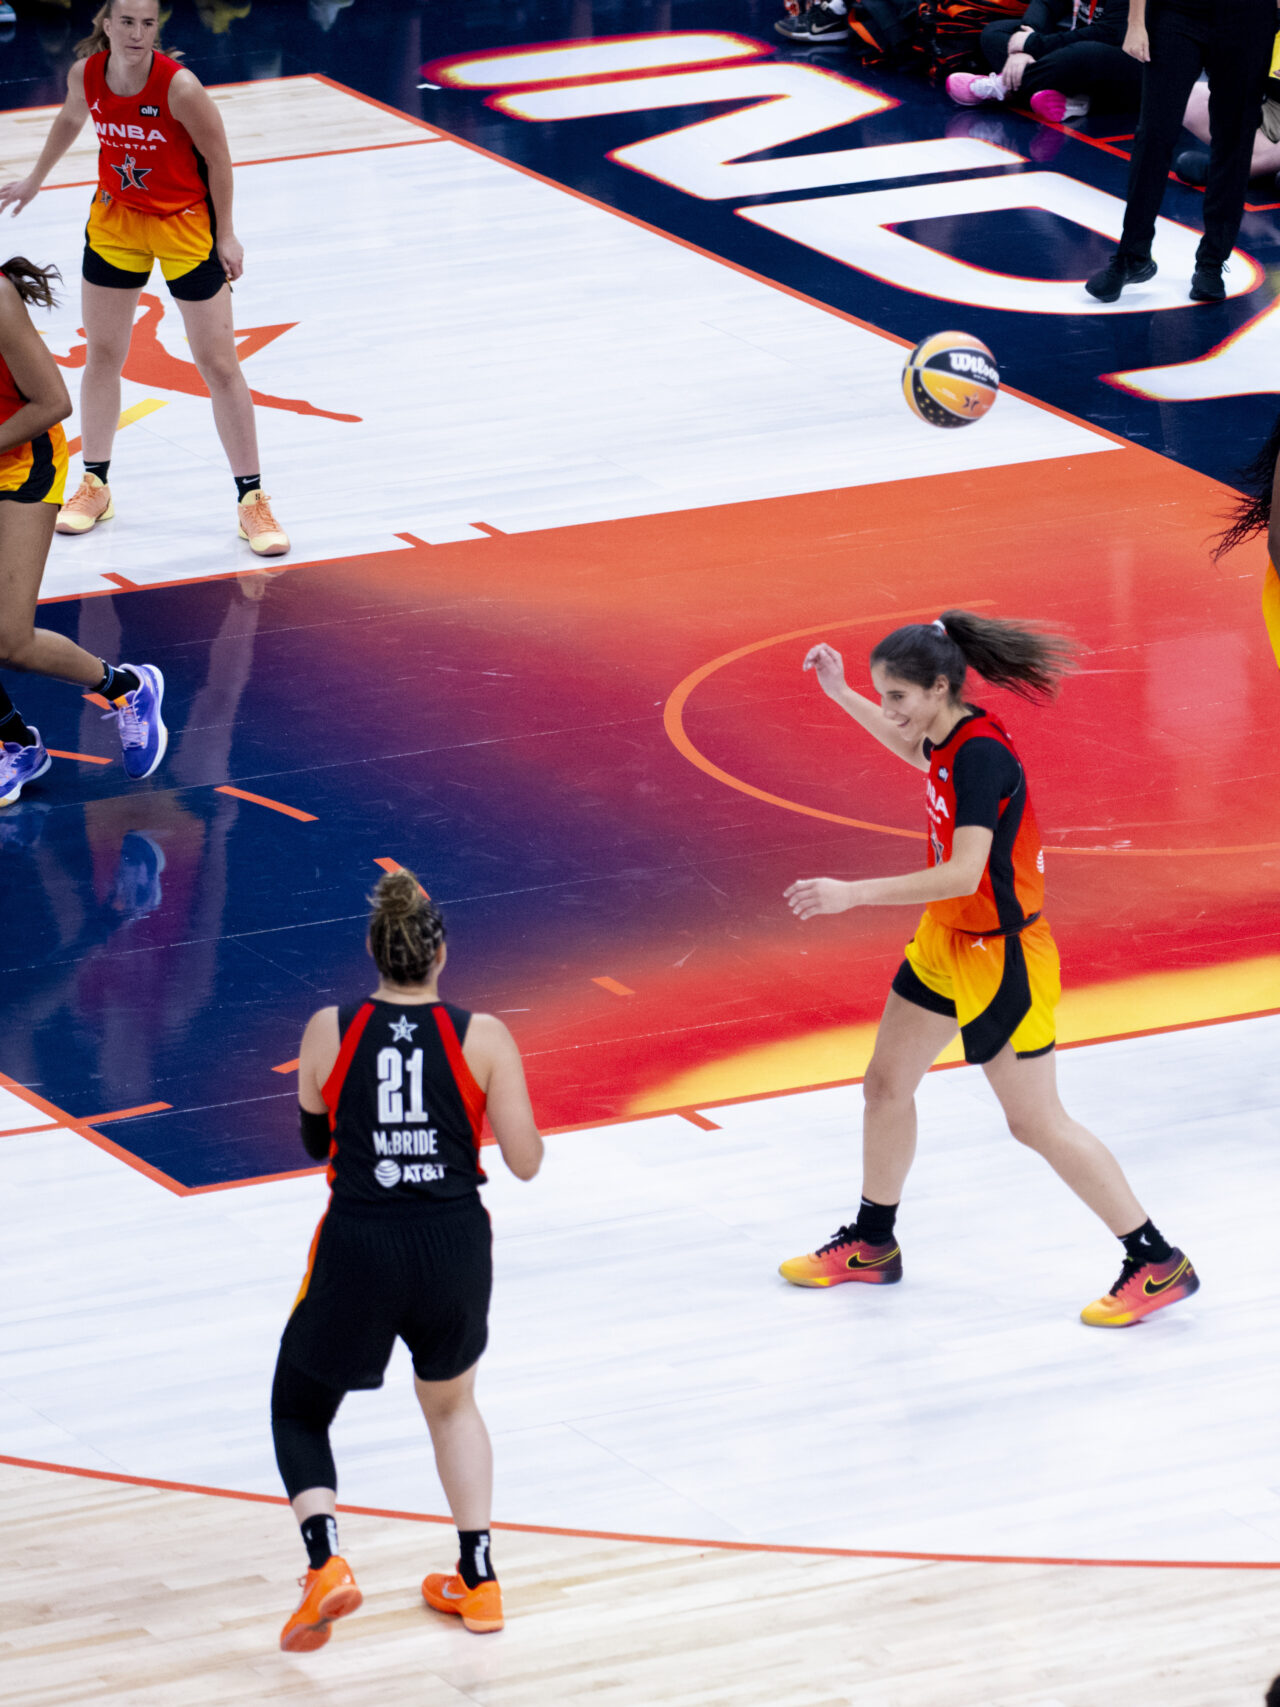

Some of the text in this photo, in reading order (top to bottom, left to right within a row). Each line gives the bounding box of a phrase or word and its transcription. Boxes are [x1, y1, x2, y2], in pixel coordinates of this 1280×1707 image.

[141, 106, 159, 117] ally
[377, 1047, 428, 1124] 21
[373, 1129, 438, 1156] McBRIDE
[403, 1163, 448, 1183] AT&T
